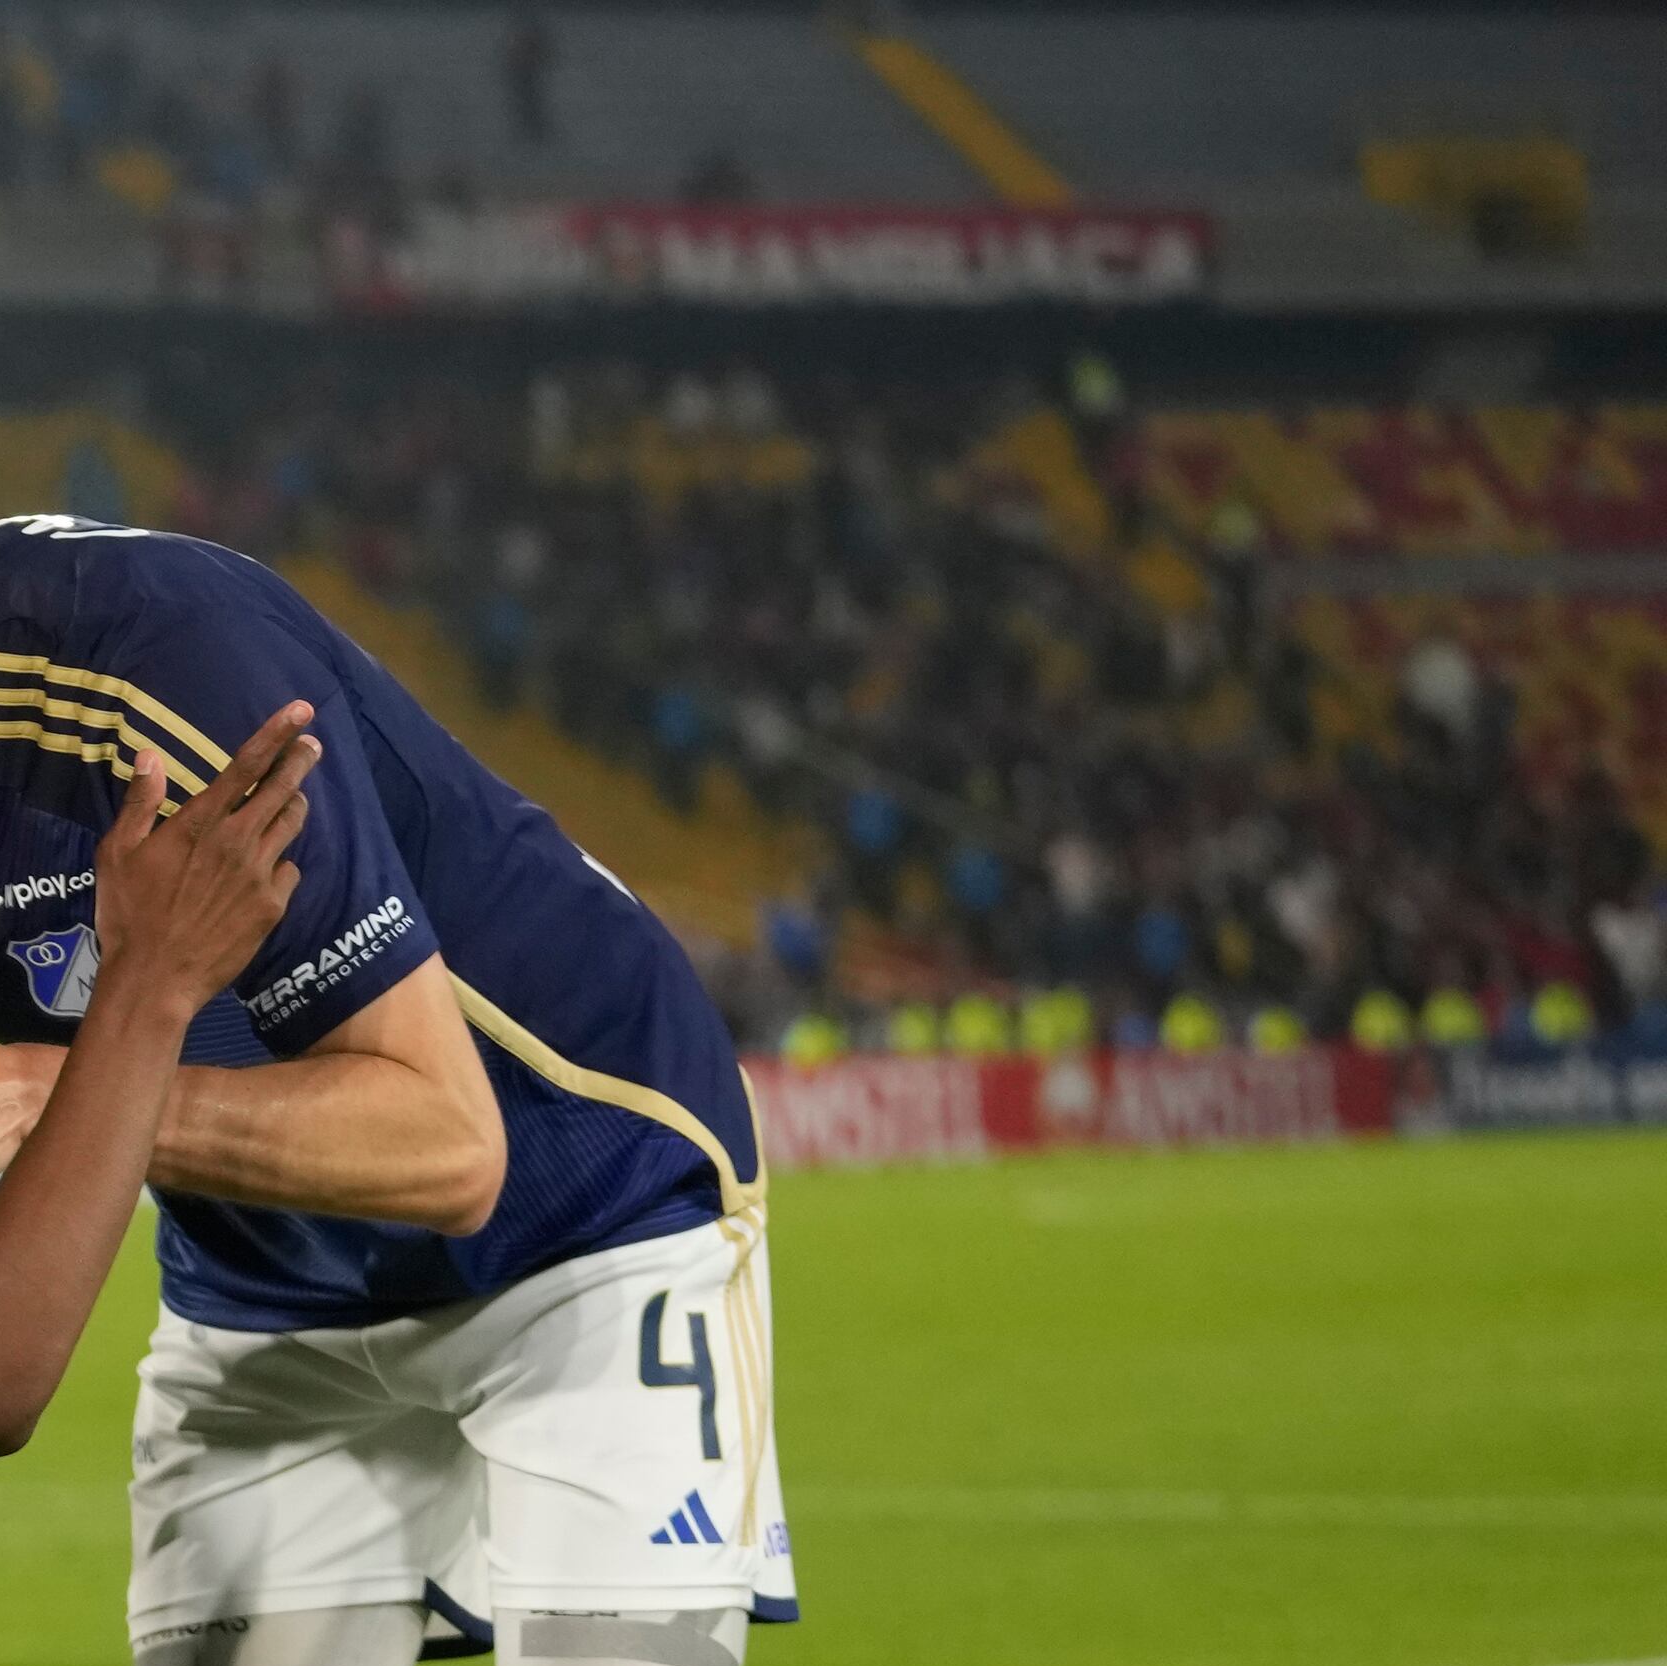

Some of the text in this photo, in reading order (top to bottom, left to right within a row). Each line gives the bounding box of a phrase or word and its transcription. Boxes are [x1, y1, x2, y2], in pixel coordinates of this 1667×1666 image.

[244, 895, 405, 1018] TERRAWIND
[258, 914, 415, 1031] GLOBAL PROTECTION
[638, 1289, 723, 1460] 4
